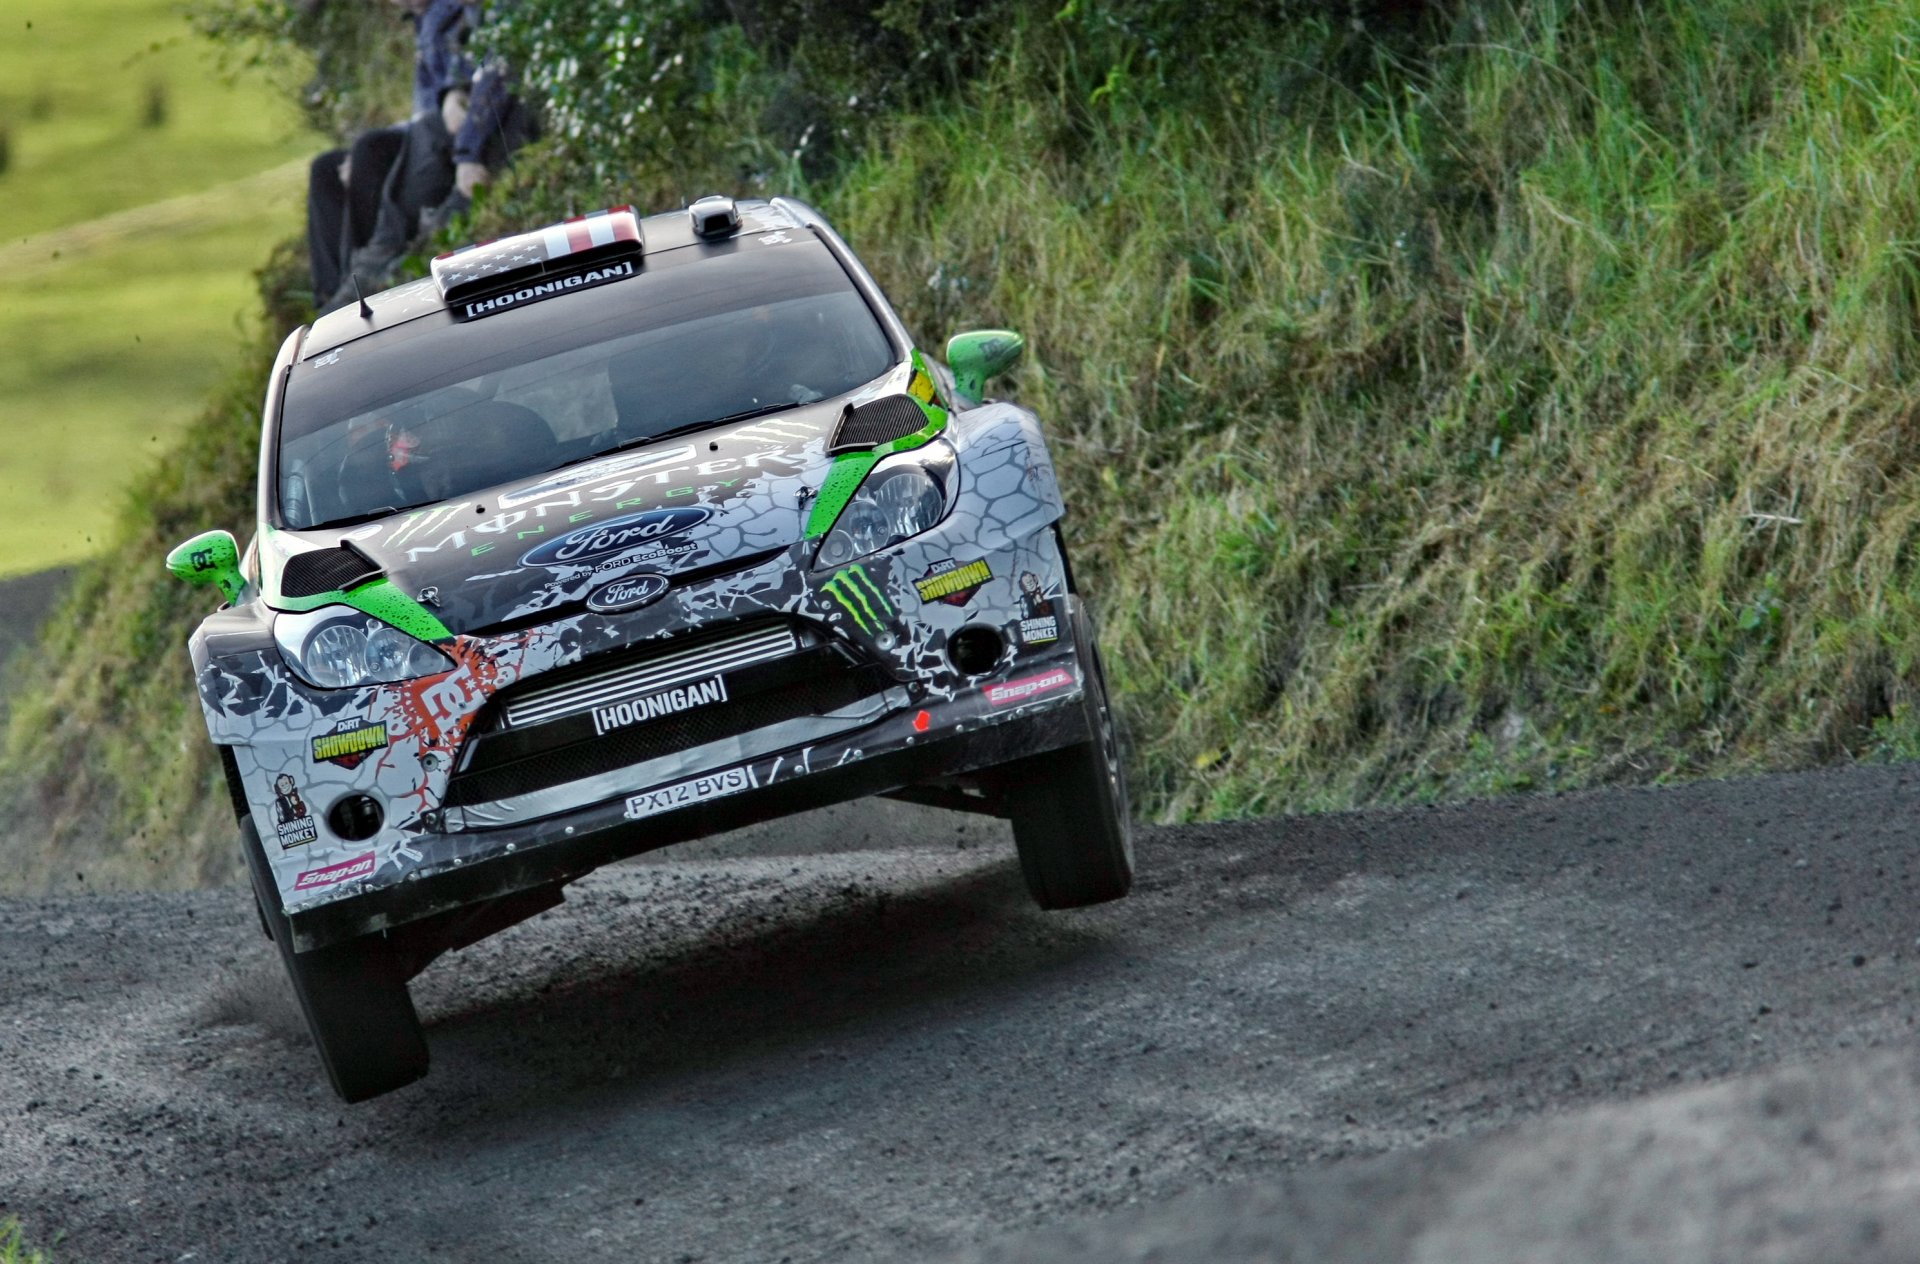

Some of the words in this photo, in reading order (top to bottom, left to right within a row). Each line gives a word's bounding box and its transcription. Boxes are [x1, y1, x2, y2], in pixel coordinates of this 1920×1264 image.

[471, 478, 740, 556] ENERGY
[555, 514, 674, 559] Ford
[544, 573, 581, 589] Powered
[582, 570, 592, 578] by
[595, 557, 631, 573] FORD
[632, 542, 697, 563] EcoBoost
[605, 580, 649, 604] Ford
[1020, 616, 1056, 631] SHINING
[1023, 627, 1057, 641] MONKEY
[313, 724, 387, 760] SHOWDOWN
[630, 784, 690, 814] PX12
[697, 770, 743, 797] BVS
[278, 817, 314, 834] SHINING
[280, 827, 318, 847] MONKEY
[299, 858, 372, 887] Snap-on
